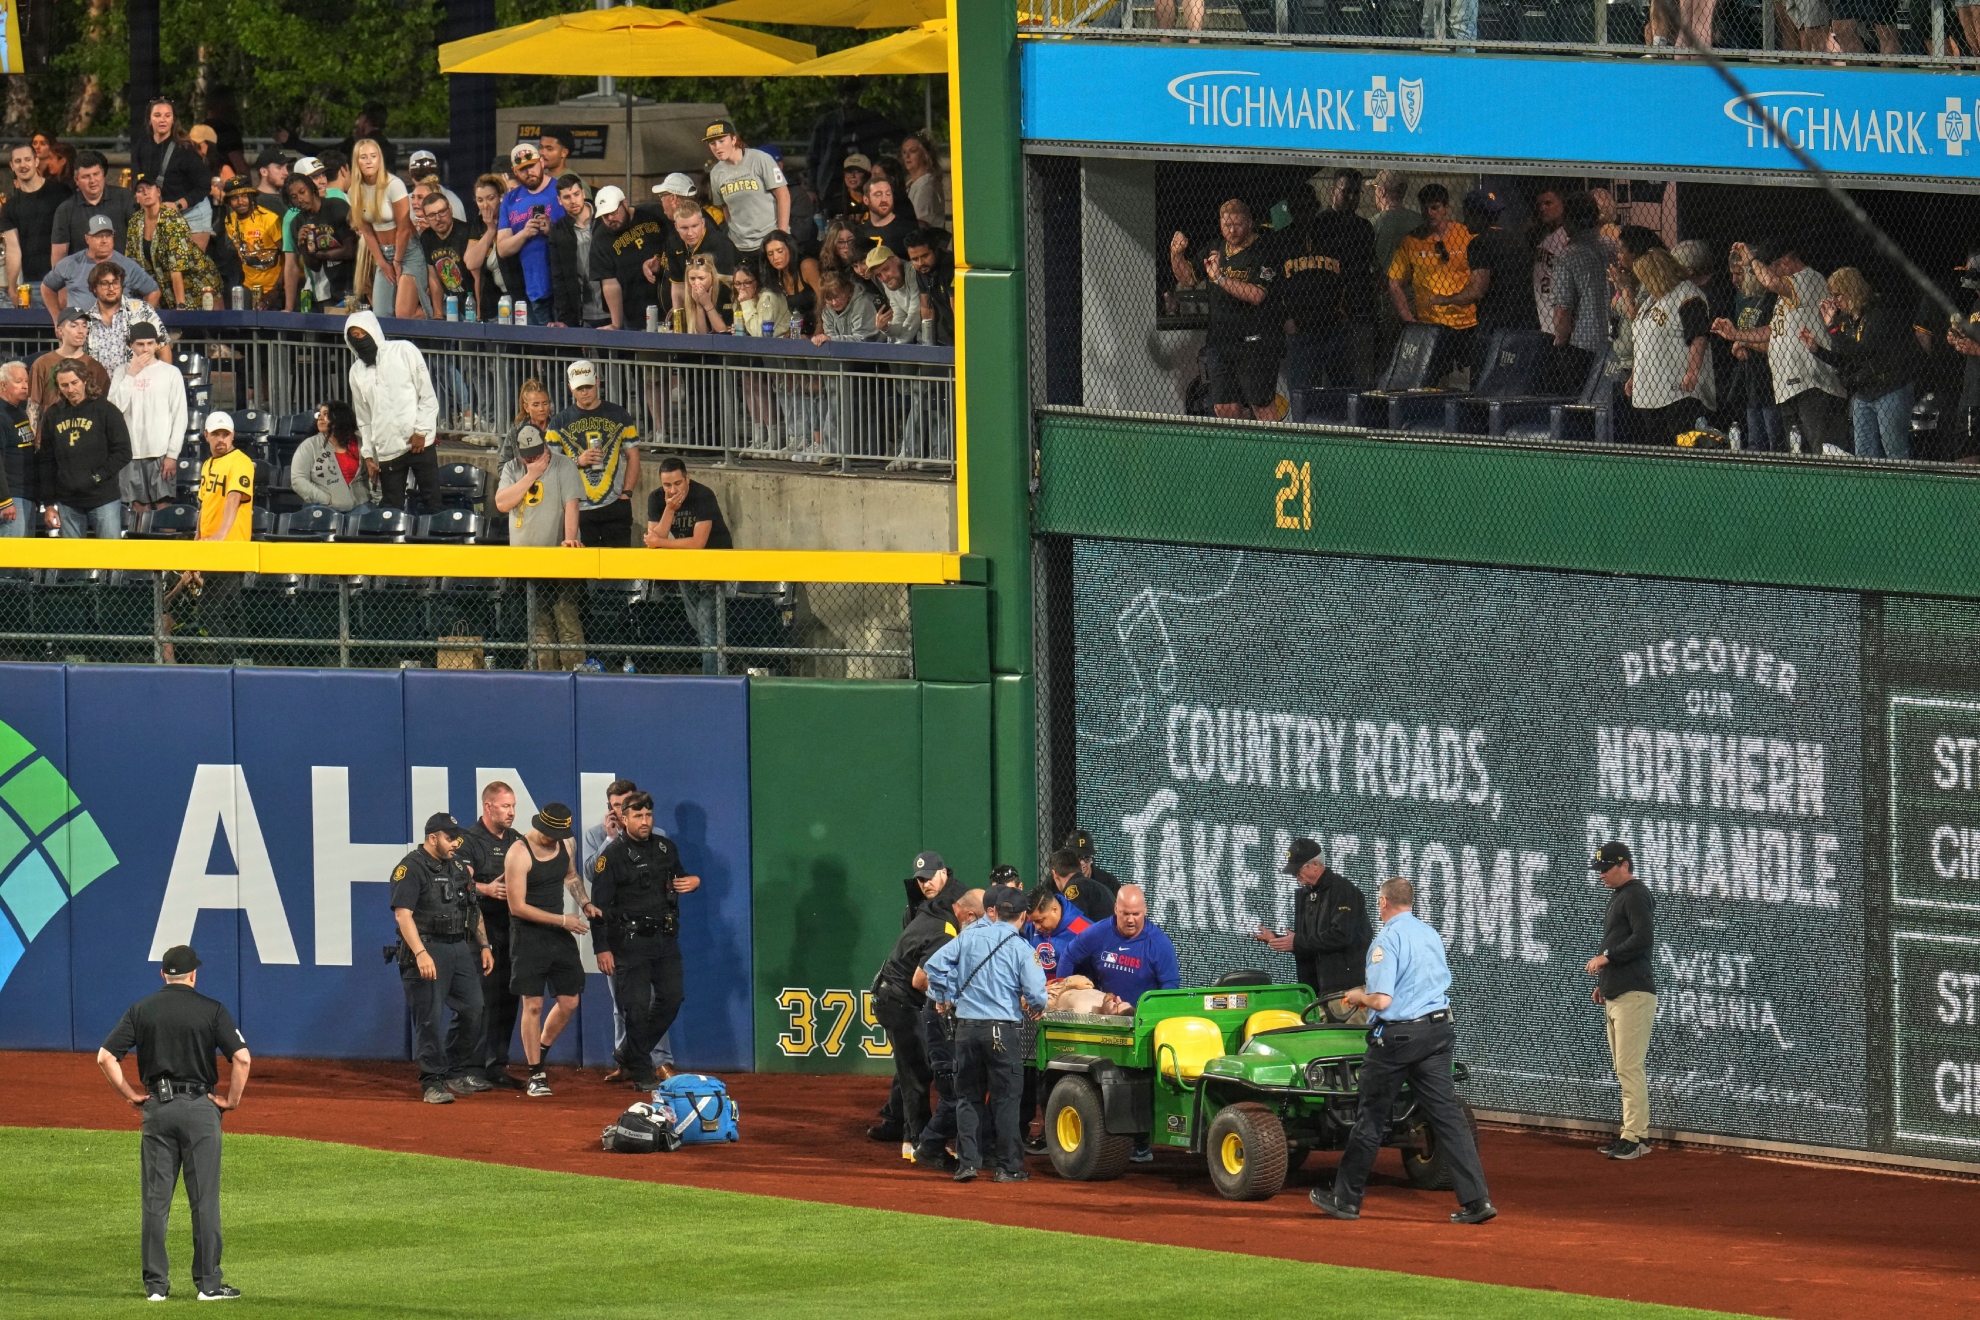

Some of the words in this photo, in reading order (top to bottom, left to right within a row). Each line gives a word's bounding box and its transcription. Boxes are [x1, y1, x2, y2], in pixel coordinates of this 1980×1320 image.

[1188, 83, 1356, 131] HIGHMARK
[1746, 104, 1928, 155] HIGHMARK
[720, 179, 759, 196] PIRATES
[613, 221, 660, 256] PIRATES
[635, 237, 644, 250] P
[56, 417, 93, 434] PIRATES
[69, 430, 80, 447] P
[526, 437, 533, 446] P
[567, 417, 618, 439] PIRATES
[1275, 459, 1312, 531] 21
[1622, 635, 1798, 696] DISCOVER
[1685, 689, 1734, 717] OUR
[1166, 703, 1347, 794] COUNTRY
[1355, 719, 1503, 822] ROADS,
[1598, 724, 1828, 816] NORTHERN
[1079, 838, 1086, 848] P
[147, 763, 616, 975] AHN
[1121, 788, 1261, 937] TAKE
[1585, 814, 1841, 908] PANHANDLE
[1103, 962, 1135, 974] BASEBALL
[1118, 954, 1142, 969] CUBS
[1659, 943, 1756, 988] WEST
[774, 987, 895, 1059] 375
[1101, 1036, 1113, 1044] JOHN
